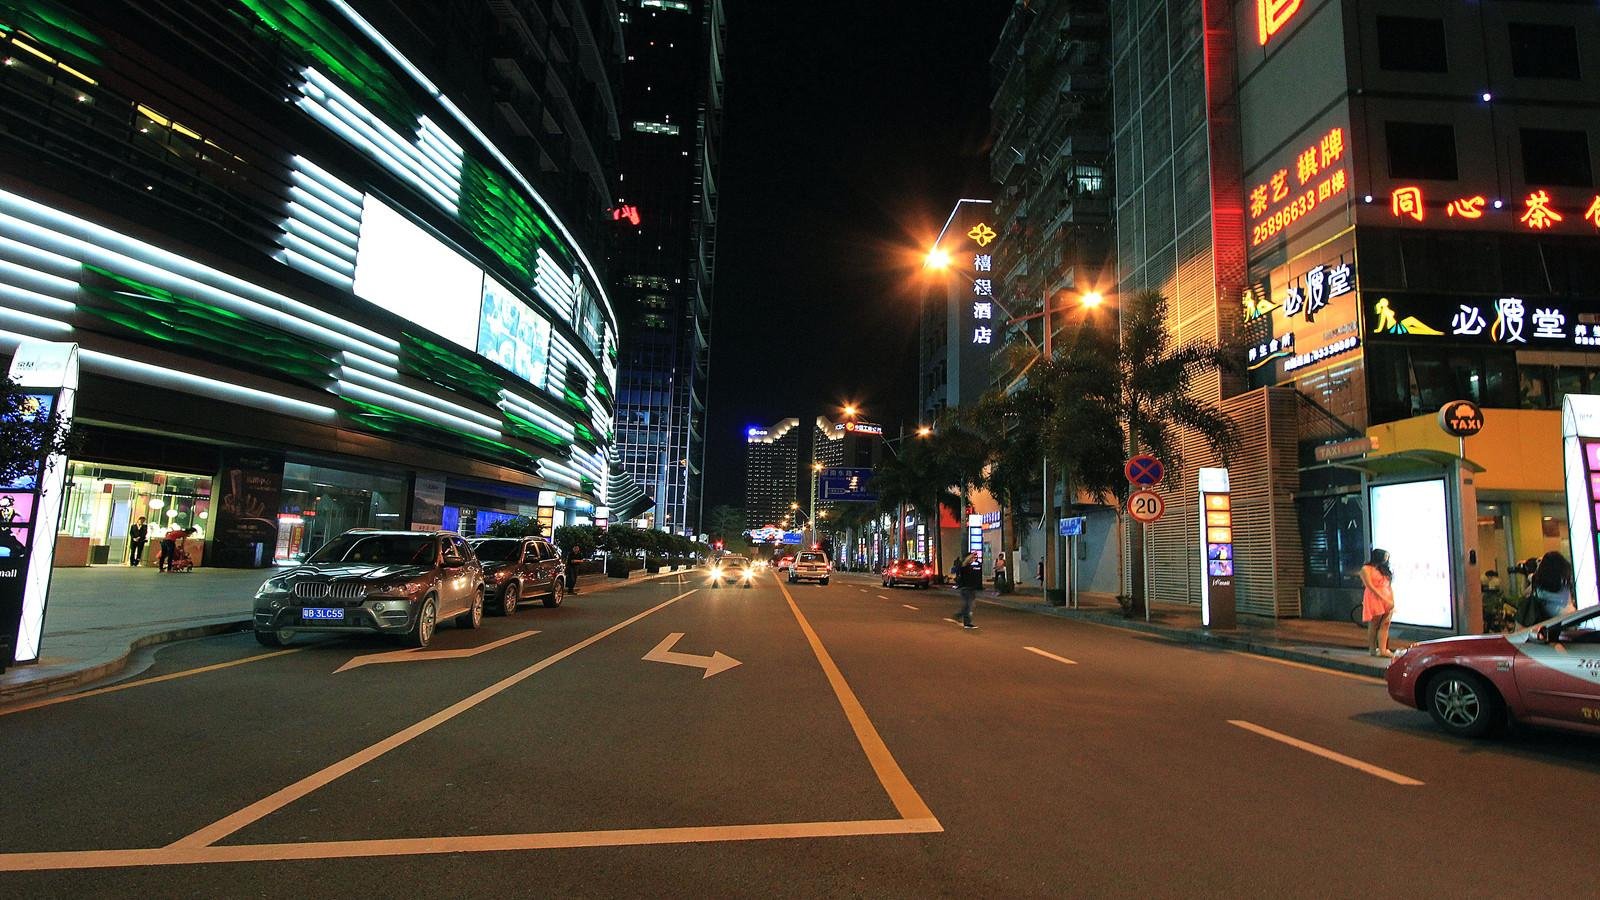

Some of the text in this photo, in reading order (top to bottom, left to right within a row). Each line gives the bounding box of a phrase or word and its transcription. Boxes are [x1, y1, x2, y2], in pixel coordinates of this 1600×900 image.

[1250, 127, 1344, 218] 茶艺 棋牌
[1253, 169, 1346, 246] 25896633 四楼
[1450, 419, 1481, 430] TAXI
[1136, 499, 1156, 514] 20
